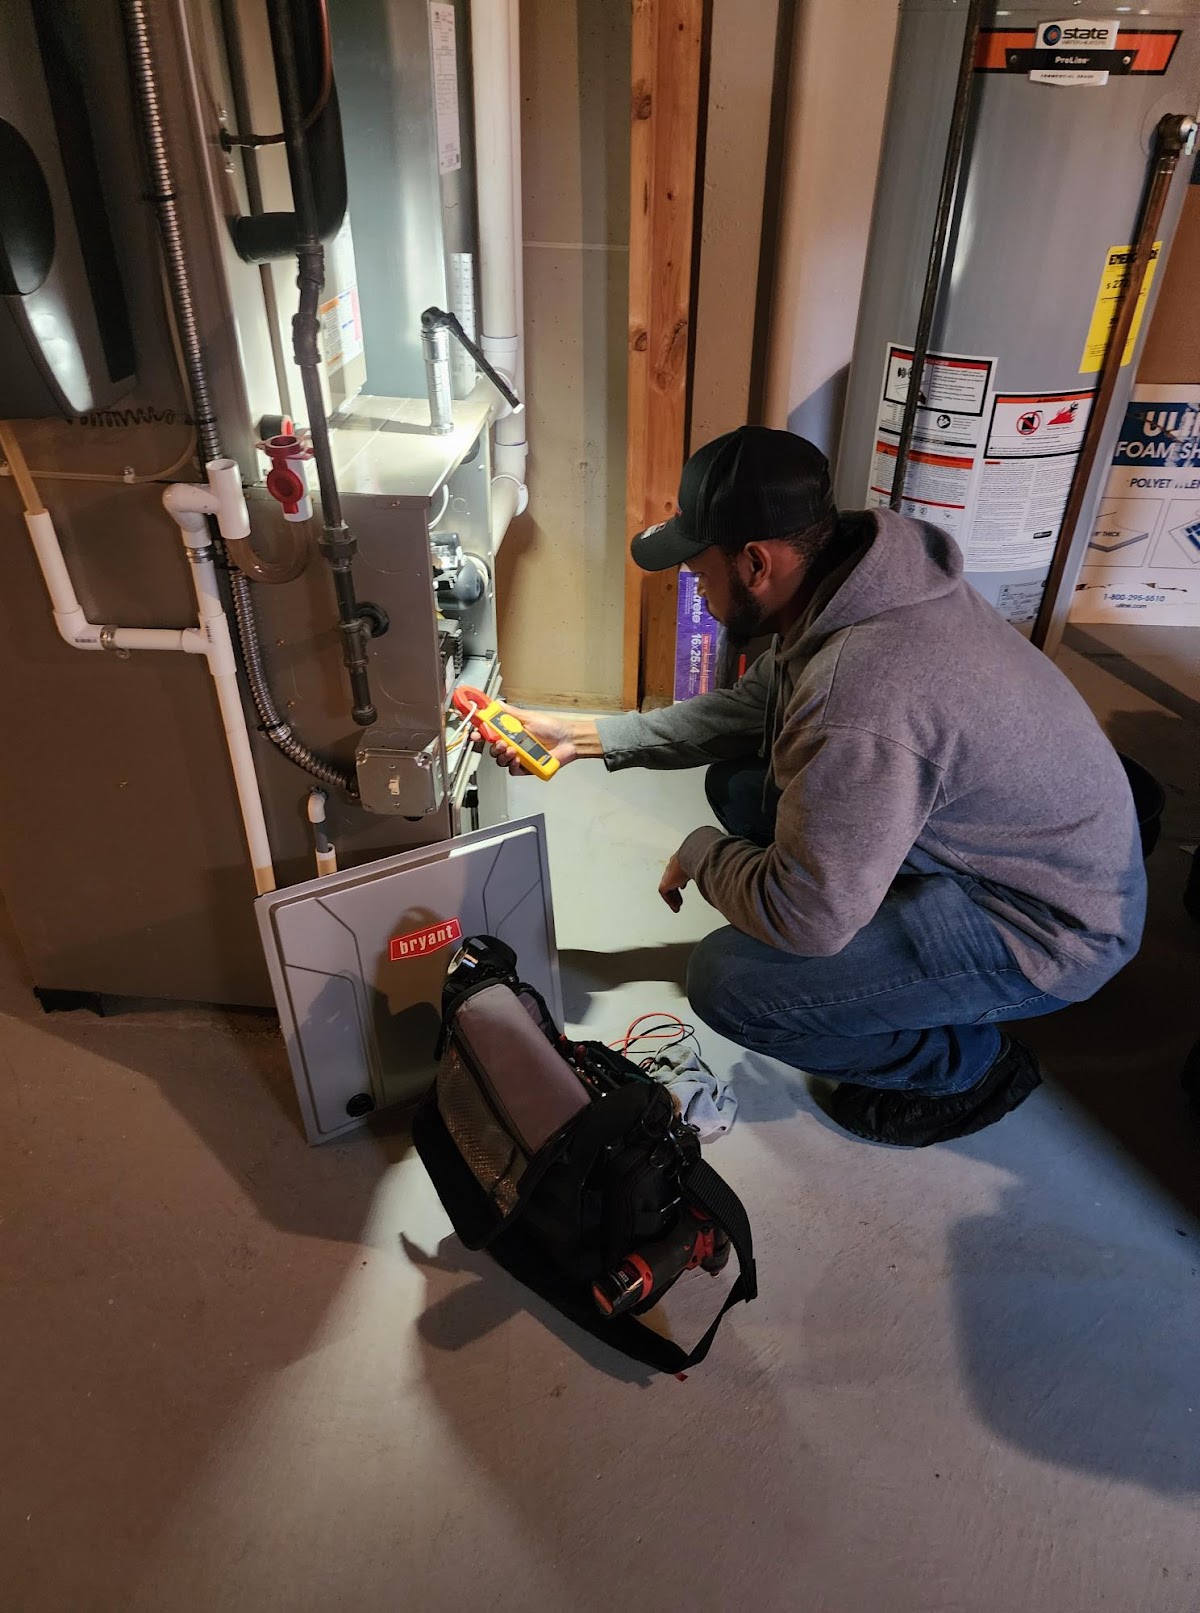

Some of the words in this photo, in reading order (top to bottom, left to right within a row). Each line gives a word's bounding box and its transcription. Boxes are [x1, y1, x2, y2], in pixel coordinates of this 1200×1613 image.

[1063, 28, 1109, 39] state
[1054, 56, 1087, 64] ProLine
[1115, 441, 1176, 458] FOAM
[400, 925, 454, 954] bryant
